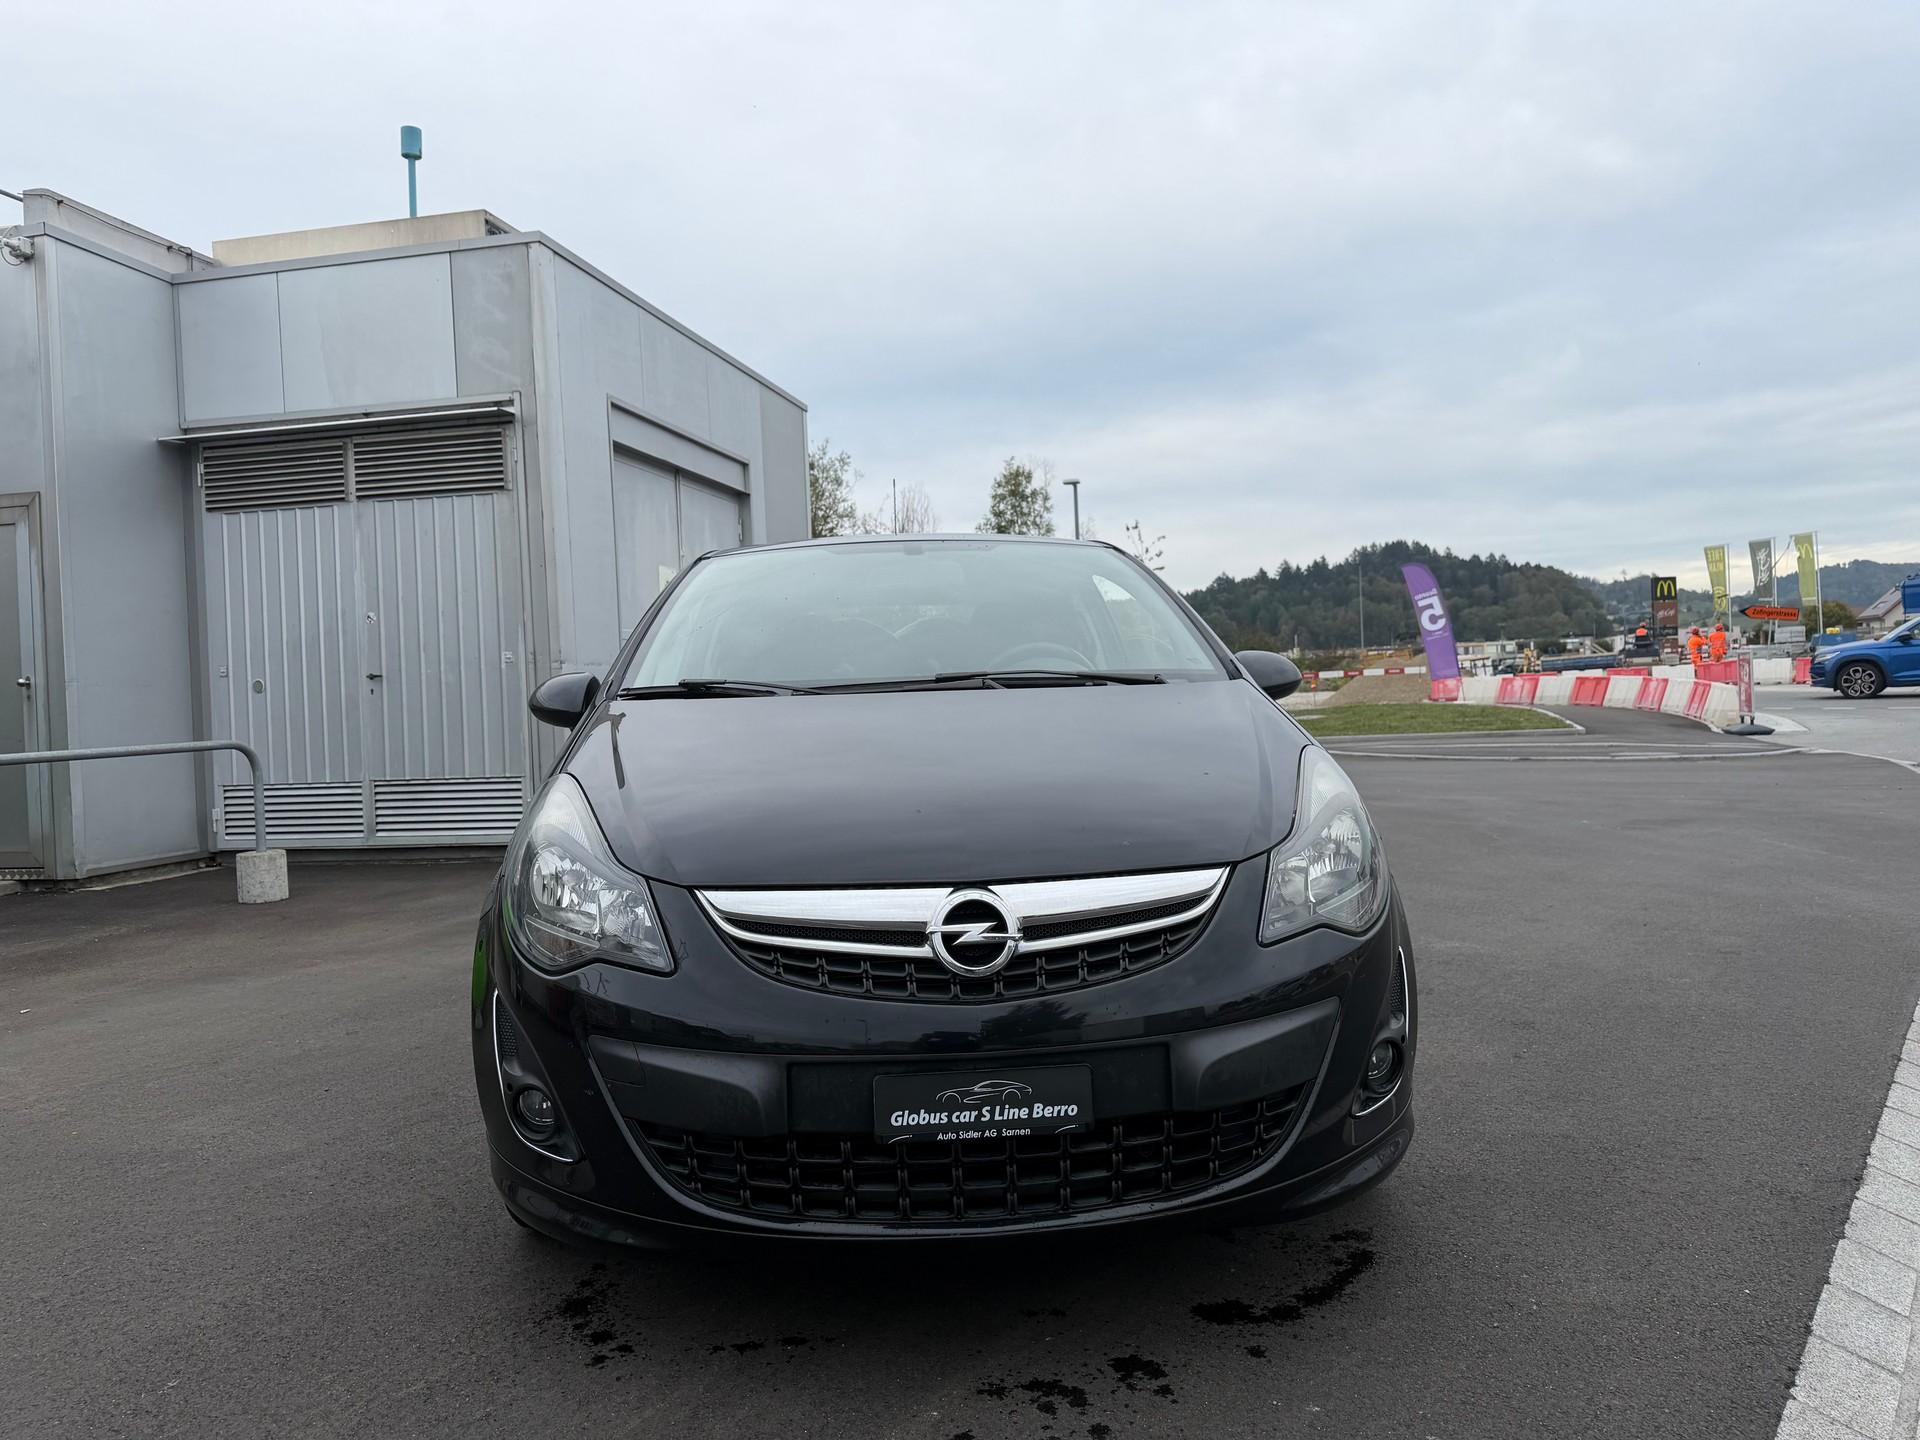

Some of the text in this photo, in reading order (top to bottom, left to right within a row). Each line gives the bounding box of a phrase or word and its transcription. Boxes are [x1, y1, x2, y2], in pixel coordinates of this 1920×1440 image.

[1752, 608, 1797, 618] Zofingerstrasse
[890, 1102, 1078, 1126] Globus car S Line Berro
[936, 1127, 1031, 1141] Auto Sidler AG Sarnen
